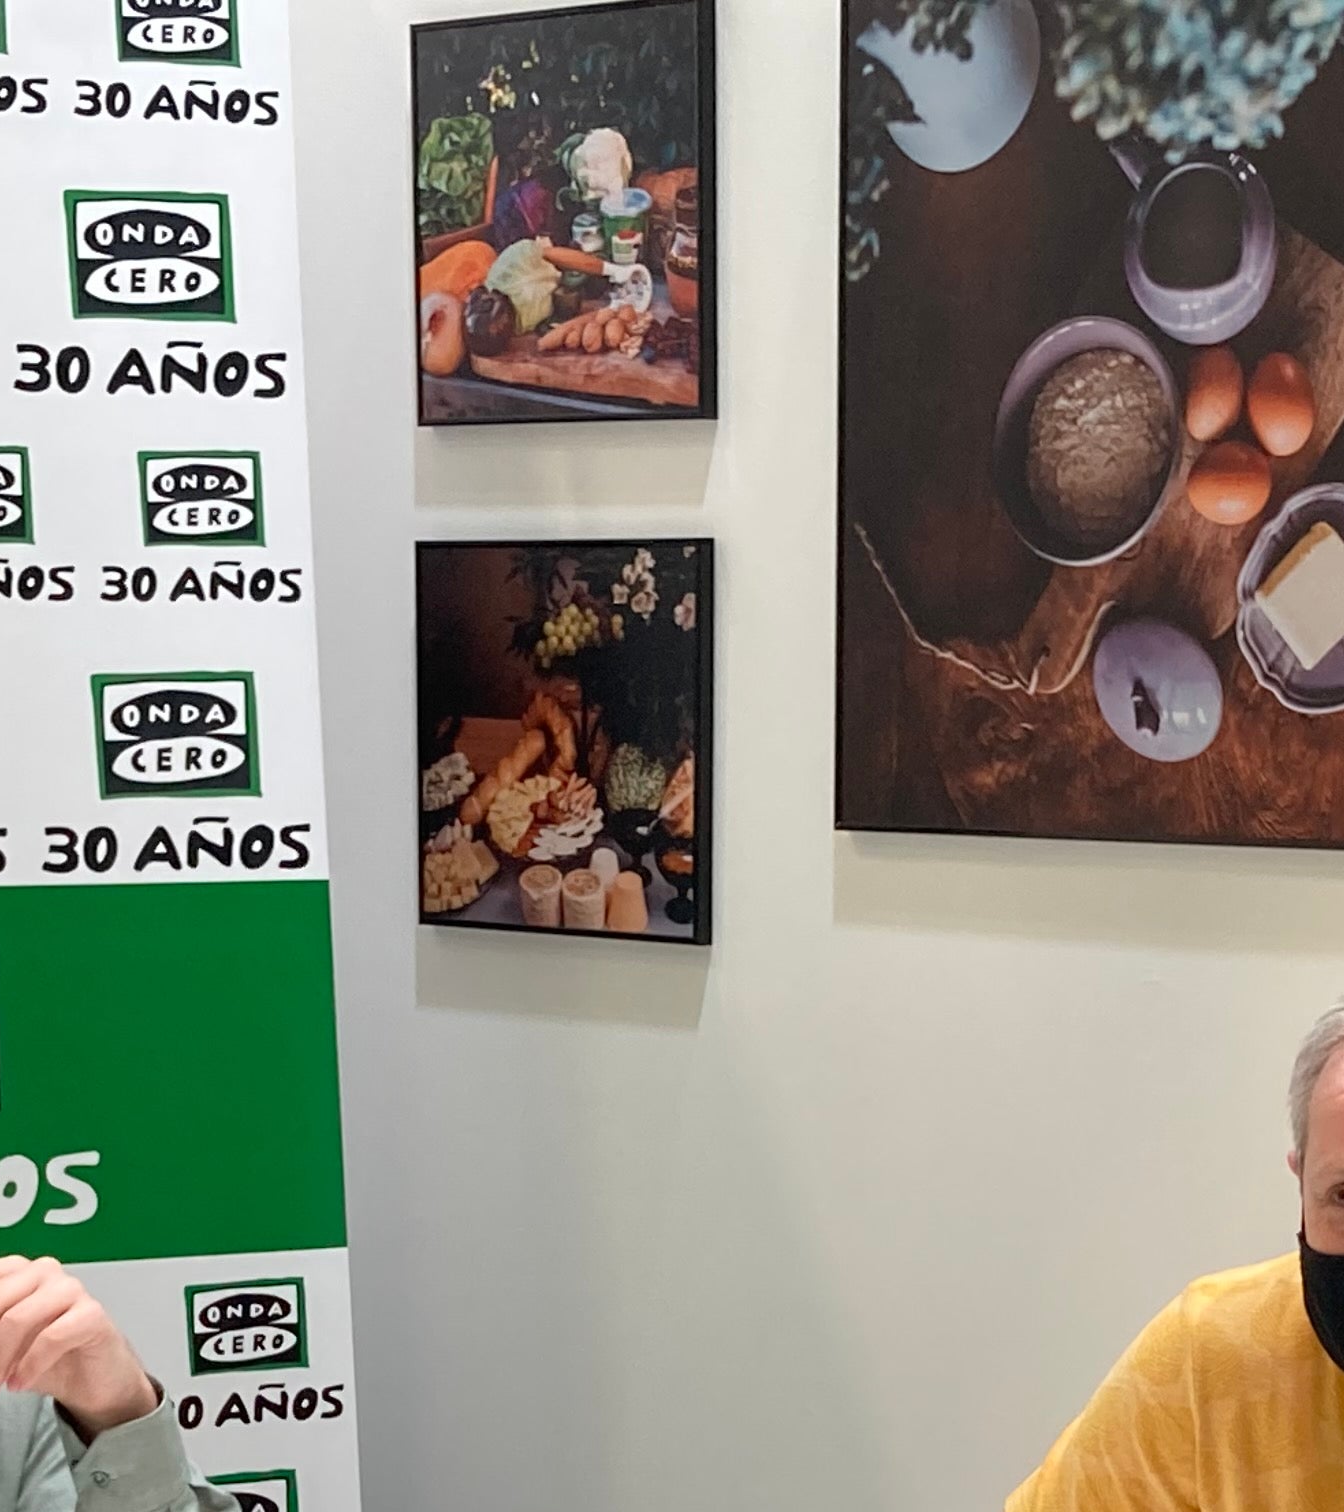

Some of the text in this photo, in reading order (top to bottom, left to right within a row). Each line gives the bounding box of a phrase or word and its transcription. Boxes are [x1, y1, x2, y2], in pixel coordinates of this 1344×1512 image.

[142, 24, 215, 44] CERO
[74, 80, 279, 126] 30 AÑOS
[95, 222, 200, 246] ONDA
[104, 268, 201, 293] CERO
[13, 341, 287, 399] 30 AÑOS
[160, 474, 239, 493] ONDA
[167, 507, 240, 527] CERO
[100, 560, 302, 603] 30 AÑOS
[122, 703, 226, 728] ONDA
[131, 746, 227, 773] CERO
[42, 816, 311, 874] 30 AÑOS
[207, 1302, 283, 1323] ONDA
[213, 1333, 284, 1356] CERO
[176, 1383, 344, 1430] 0 AÑOS
